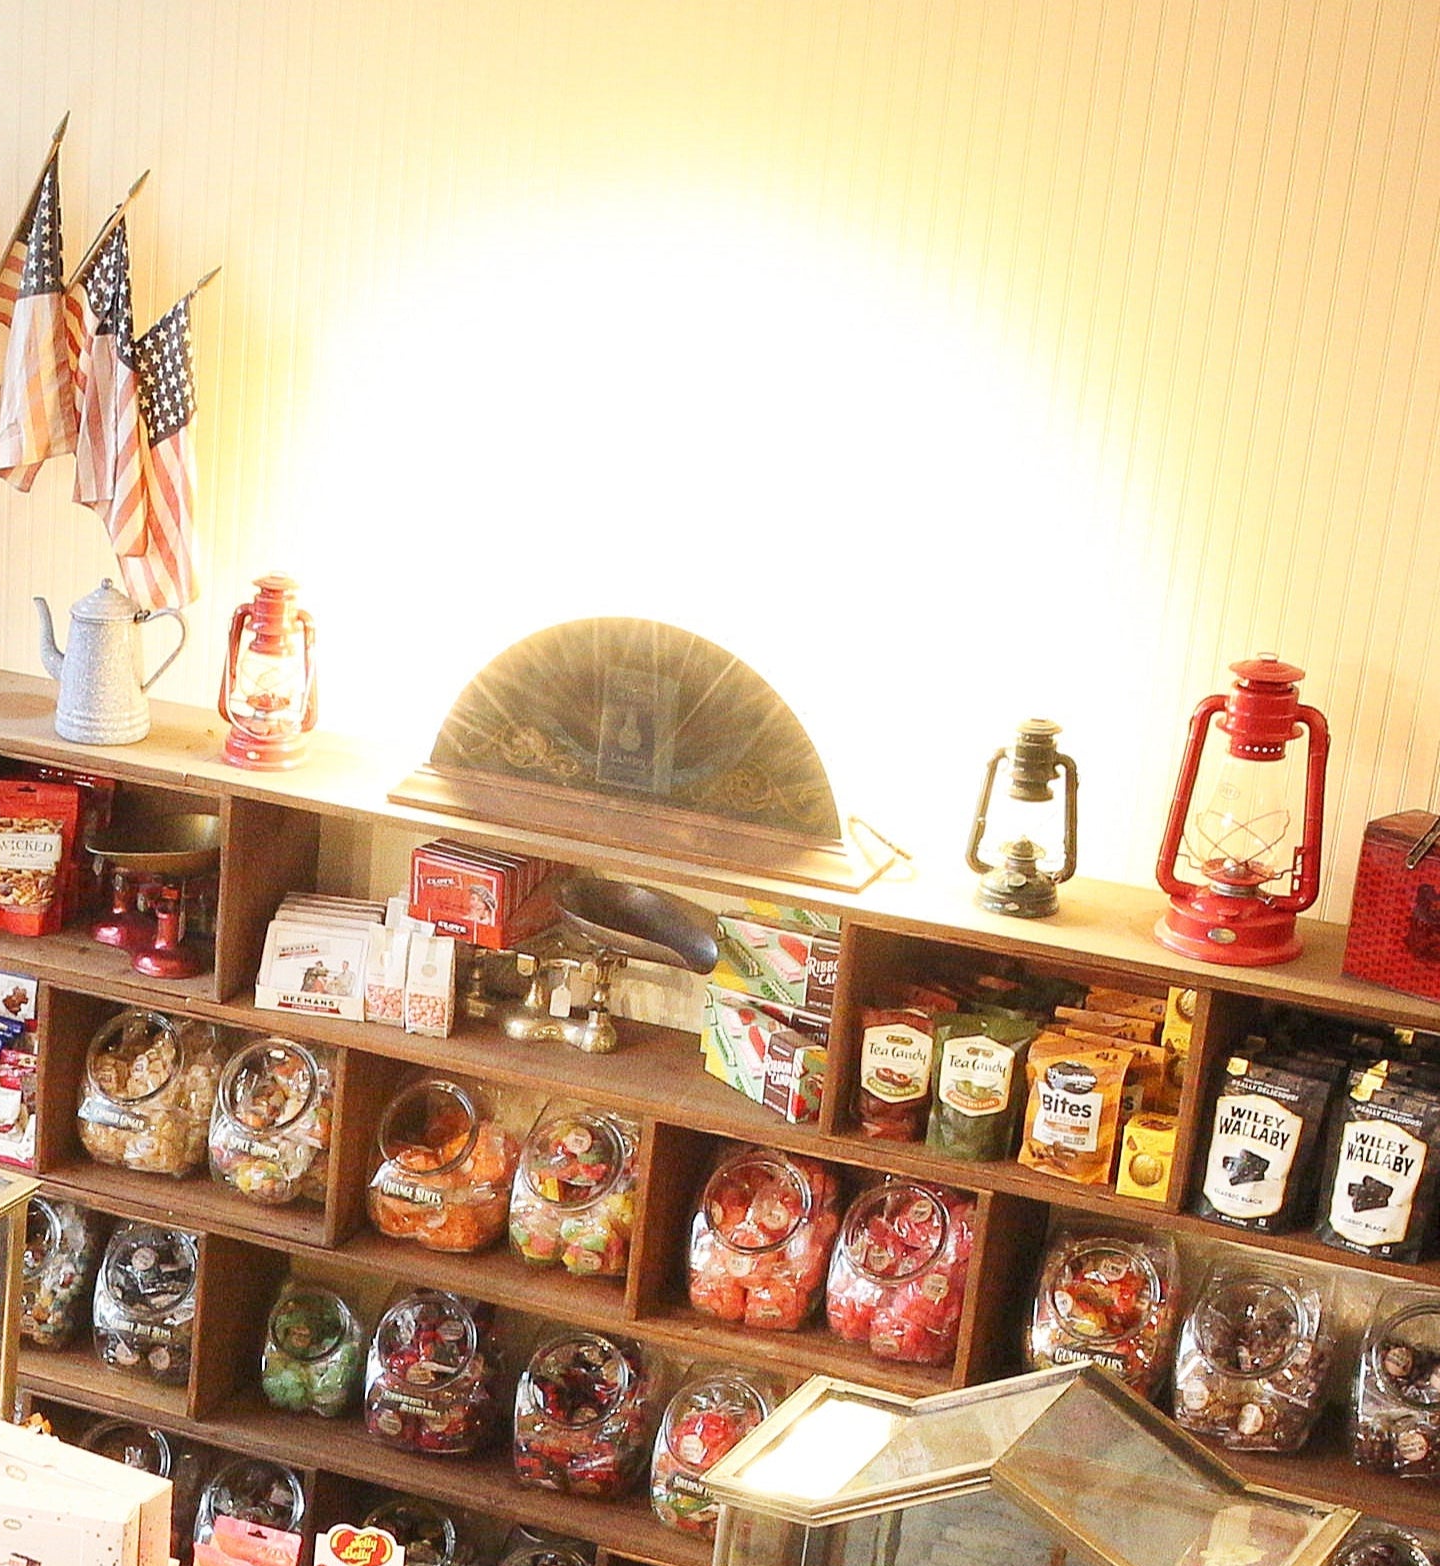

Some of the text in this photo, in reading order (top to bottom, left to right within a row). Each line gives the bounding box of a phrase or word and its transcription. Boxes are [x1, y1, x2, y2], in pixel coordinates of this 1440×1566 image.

[868, 1041, 928, 1066] Tea Candy
[948, 1054, 1008, 1079] Tea Candy
[1042, 1093, 1093, 1119] Bites
[1230, 1105, 1287, 1129] WILEY
[1218, 1116, 1291, 1151] WALLABY
[1354, 1131, 1410, 1155] WILEY
[1346, 1142, 1416, 1177] WALLABY
